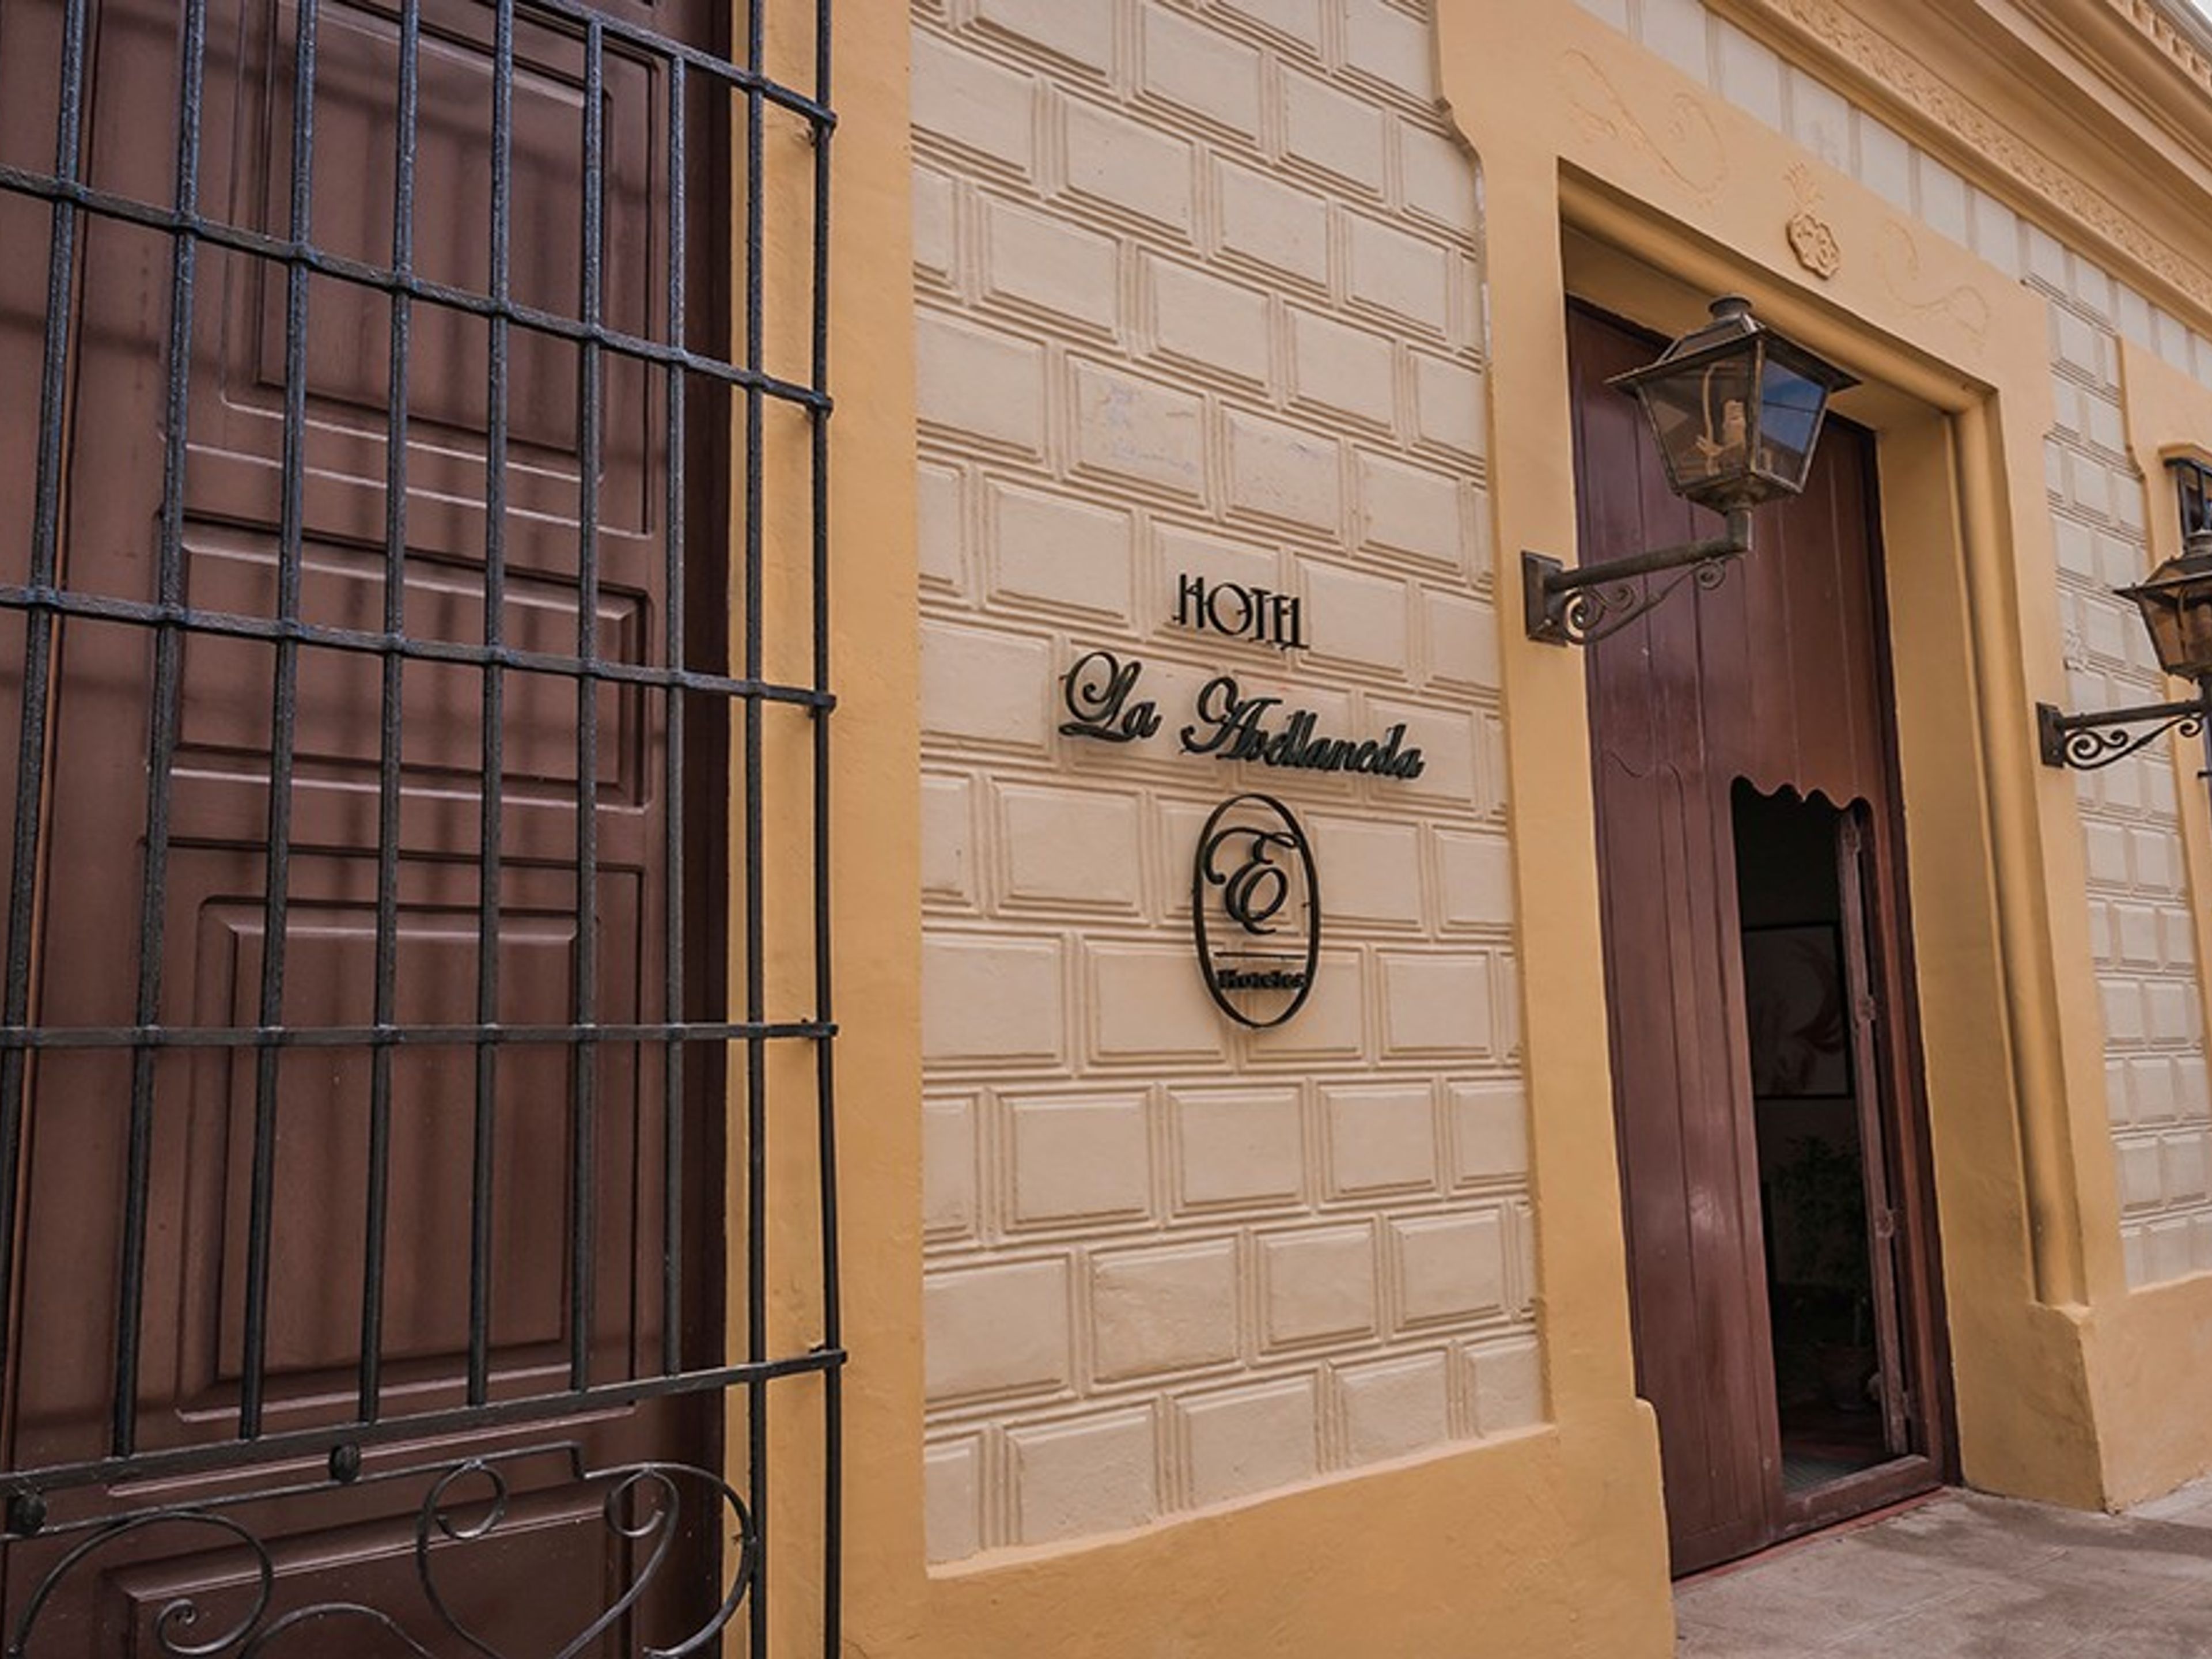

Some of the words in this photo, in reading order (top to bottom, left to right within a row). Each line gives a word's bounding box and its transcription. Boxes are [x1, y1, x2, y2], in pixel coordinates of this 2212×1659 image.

[1172, 574, 1309, 650] HOTEL
[1059, 652, 1162, 743] La
[1180, 676, 1425, 779] Avellaneda
